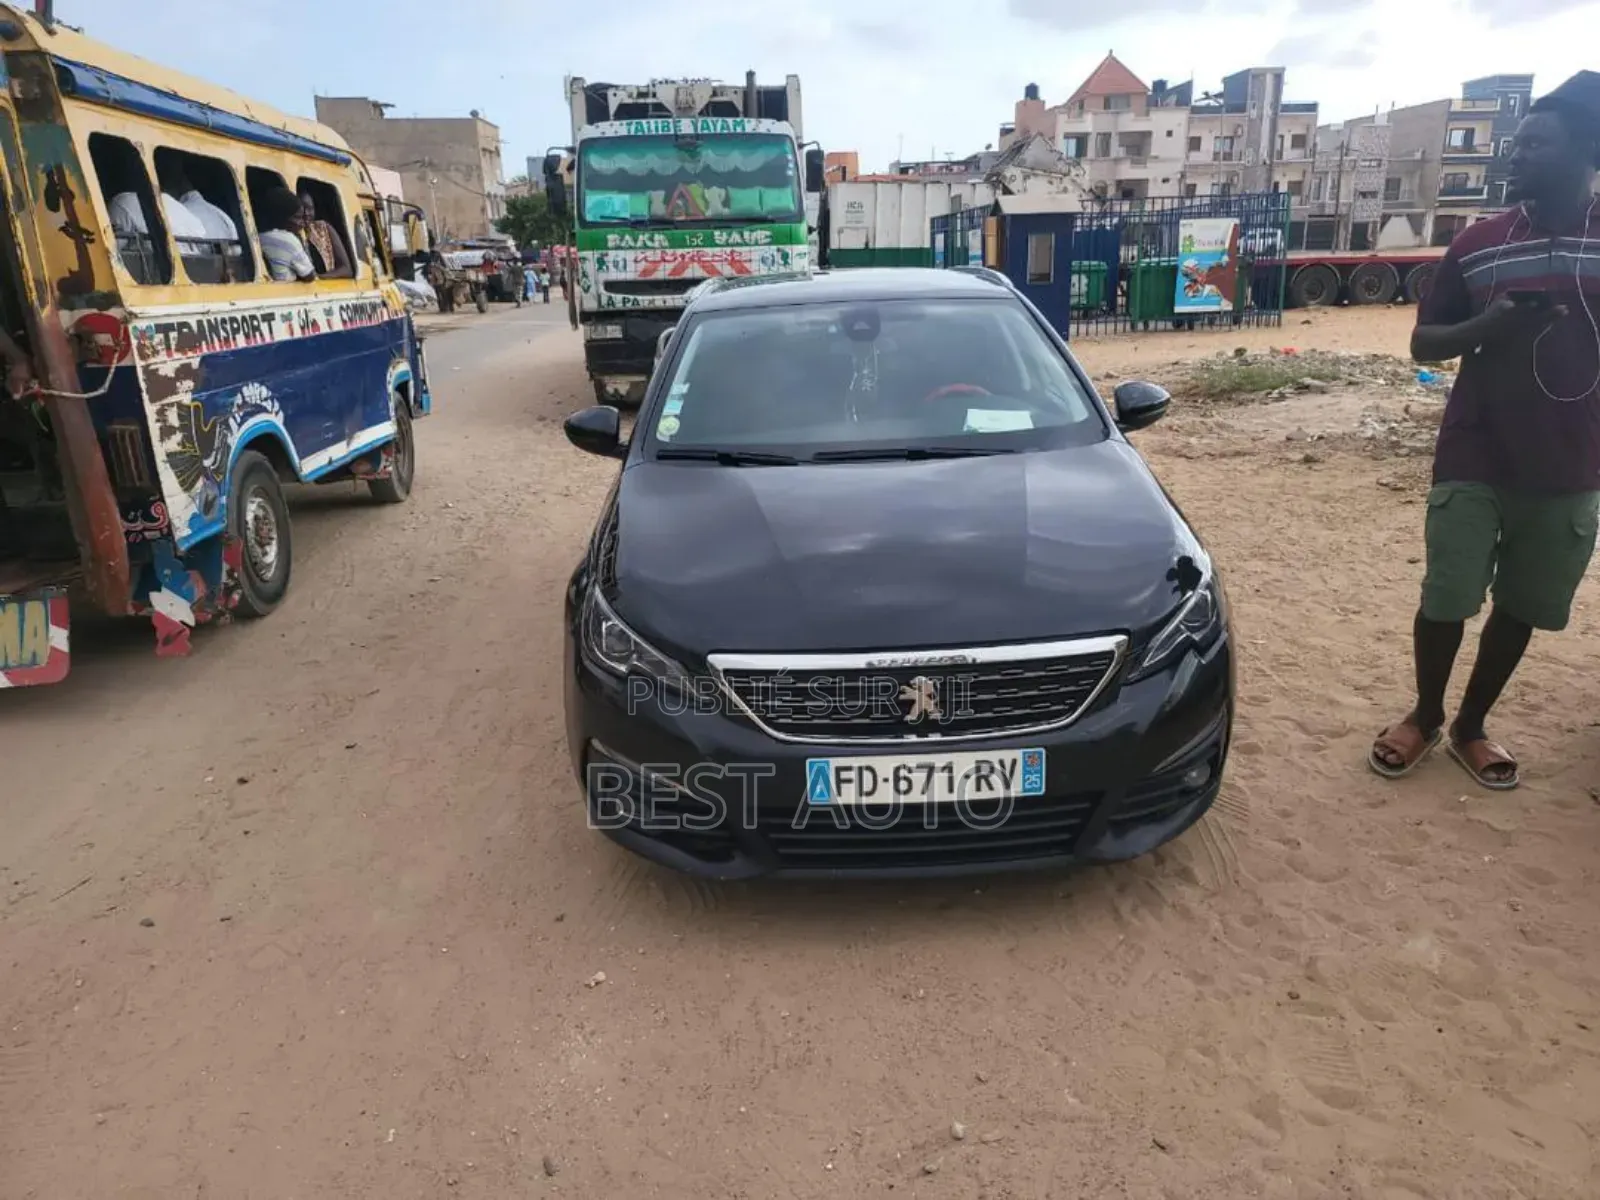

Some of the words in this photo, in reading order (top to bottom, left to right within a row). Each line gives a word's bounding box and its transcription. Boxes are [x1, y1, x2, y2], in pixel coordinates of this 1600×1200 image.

[154, 312, 276, 359] TRANSPORT
[834, 757, 1018, 798] FD-671-RV
[1024, 774, 1041, 789] 25
